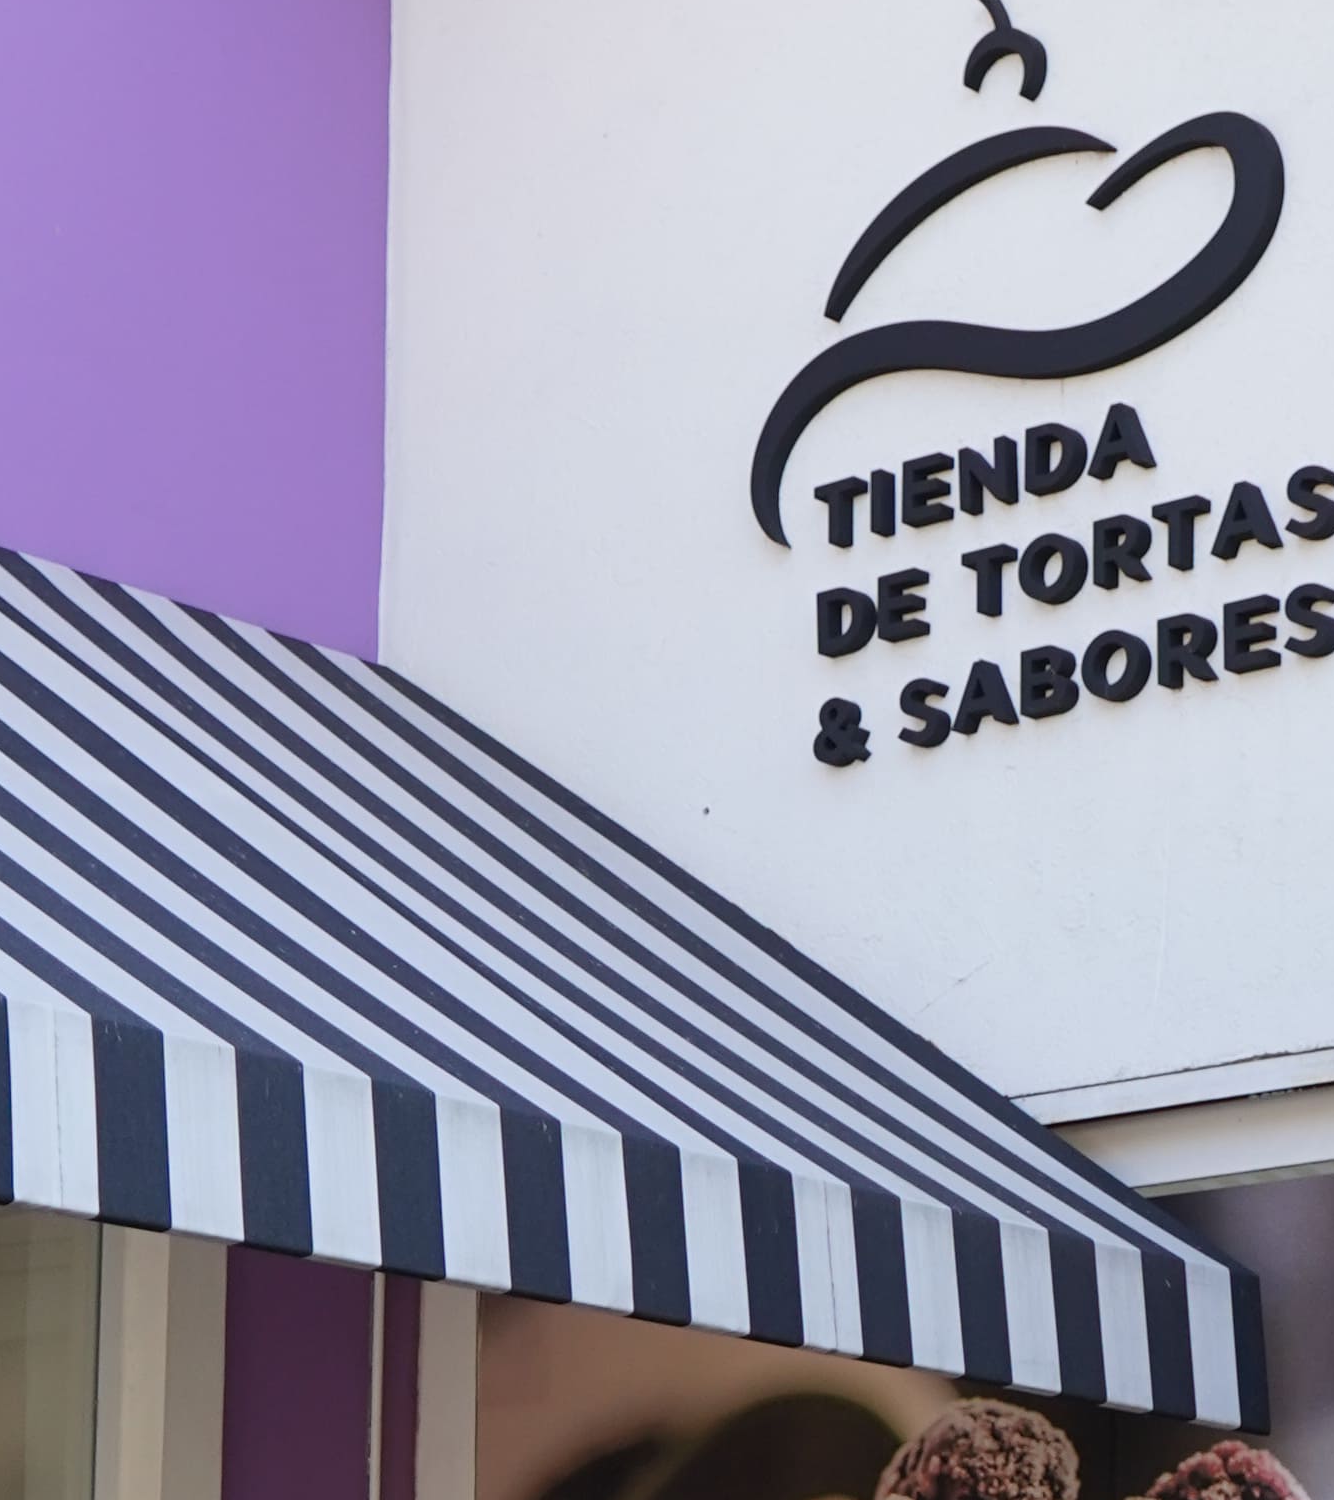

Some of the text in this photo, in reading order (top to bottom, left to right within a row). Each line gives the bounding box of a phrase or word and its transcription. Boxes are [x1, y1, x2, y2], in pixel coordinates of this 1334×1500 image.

[814, 403, 1156, 548] TIENDA
[817, 567, 931, 658] DE
[813, 697, 871, 767] &
